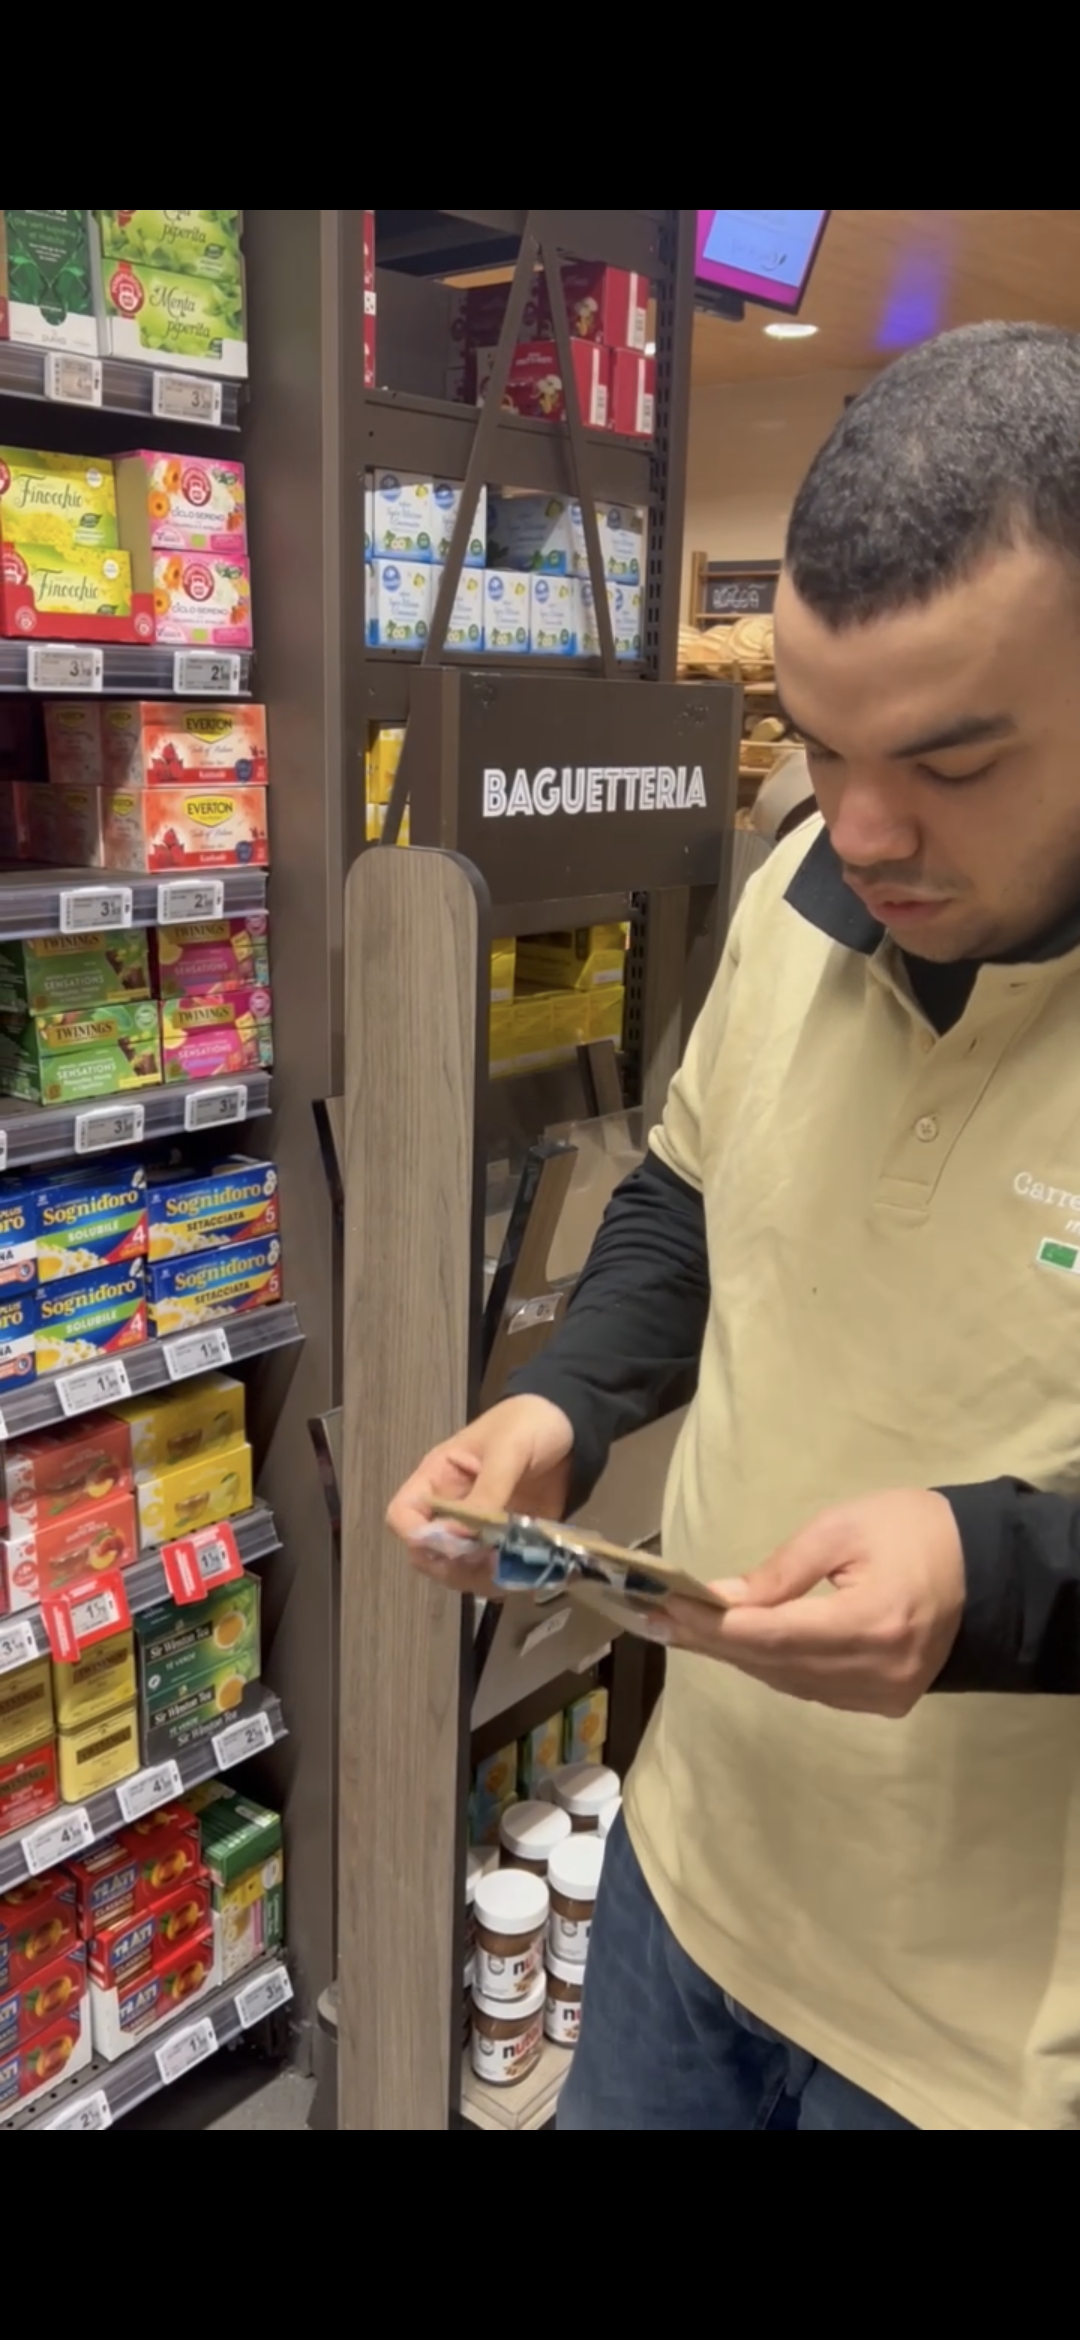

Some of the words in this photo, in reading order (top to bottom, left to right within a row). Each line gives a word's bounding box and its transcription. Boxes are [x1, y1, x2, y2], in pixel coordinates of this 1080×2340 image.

[162, 223, 206, 244] piperita
[149, 286, 196, 319] Menta
[161, 319, 211, 341] piperita
[185, 717, 233, 731] EVERTON
[483, 766, 707, 817] BAGUETTERIA
[187, 801, 233, 815] EVERTON
[178, 1006, 229, 1022] TWININGS
[55, 1022, 113, 1039] TWININGS
[178, 1043, 232, 1060] SENSATIONS
[57, 1062, 116, 1079] SENSATIONS
[186, 1210, 245, 1233] SETACCIATA
[265, 1205, 276, 1223] 5
[68, 1219, 119, 1243] SOLUBILE
[132, 1224, 145, 1243] 4
[193, 1280, 250, 1305] SETACCIATA
[269, 1274, 279, 1292] 5
[65, 1309, 117, 1334] SOLUBILE
[130, 1312, 144, 1332] 4
[155, 1712, 167, 1726] Sir
[167, 1698, 199, 1718] Winston
[198, 1691, 212, 1703] Tea
